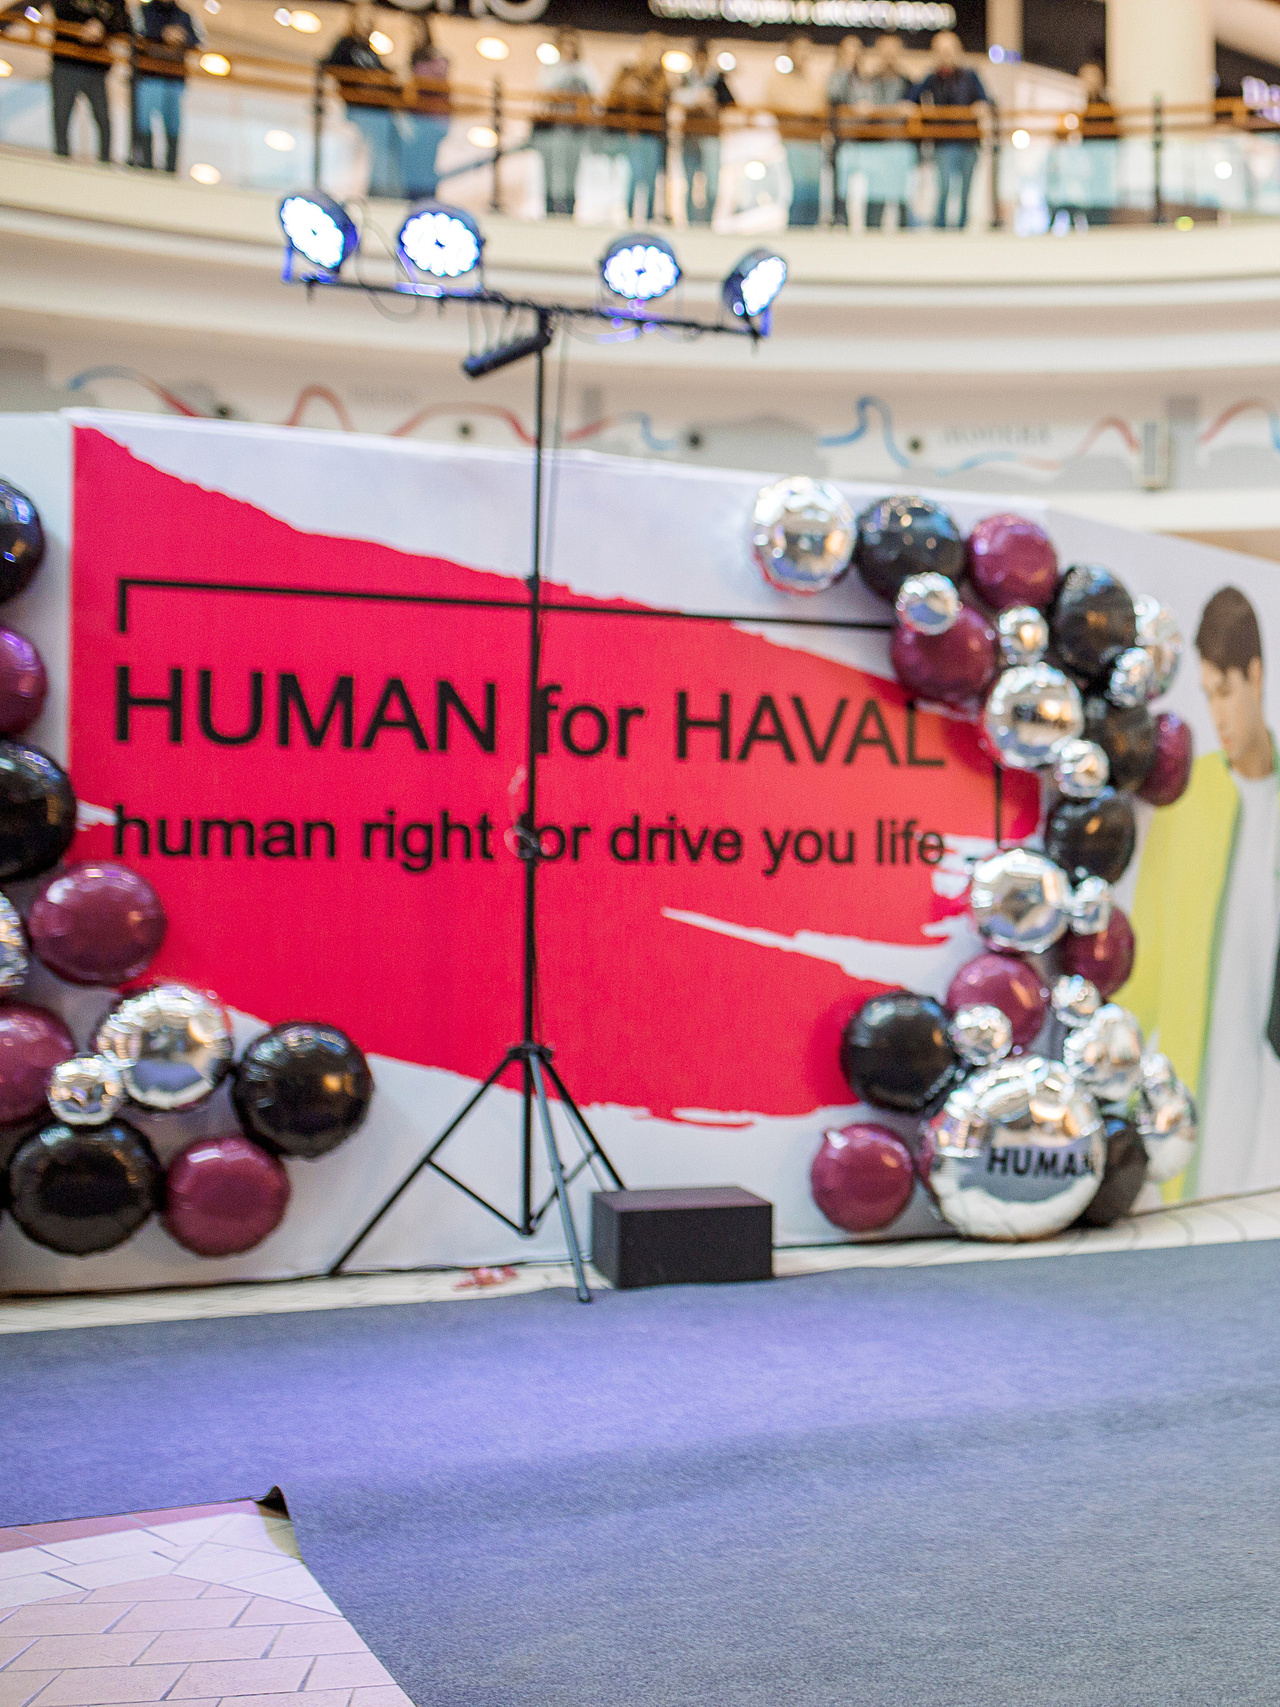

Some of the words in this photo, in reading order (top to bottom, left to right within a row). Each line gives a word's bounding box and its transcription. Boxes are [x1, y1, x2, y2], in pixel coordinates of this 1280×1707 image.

[115, 665, 496, 753] HUMAN
[532, 684, 645, 758] for
[676, 690, 945, 767] HAVAL
[113, 804, 336, 858] human
[362, 809, 494, 873] right
[609, 814, 743, 862] drive
[762, 826, 855, 876] you
[875, 818, 945, 864] life
